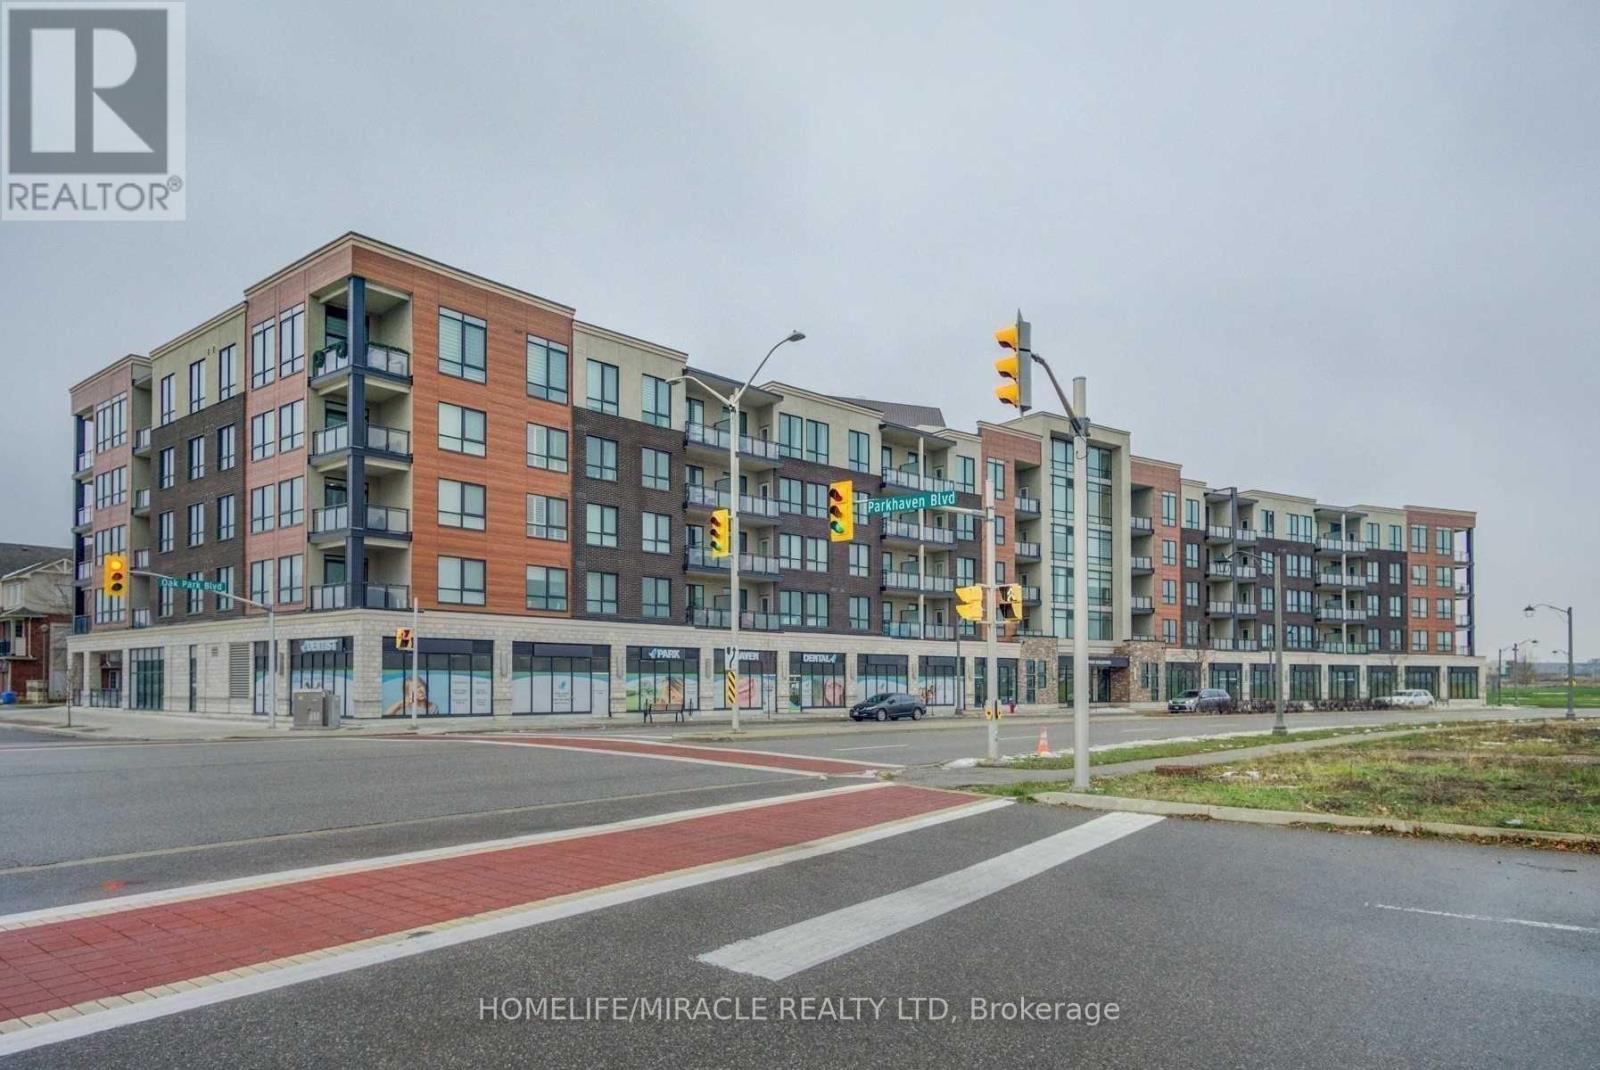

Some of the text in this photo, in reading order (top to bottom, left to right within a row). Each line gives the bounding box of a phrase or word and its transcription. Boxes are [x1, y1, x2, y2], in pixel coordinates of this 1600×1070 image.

[868, 491, 956, 513] Parkhaven Blvd
[161, 579, 223, 590] Oak Park Blvd
[657, 649, 681, 659] PARK
[803, 653, 832, 663] DENTAL
